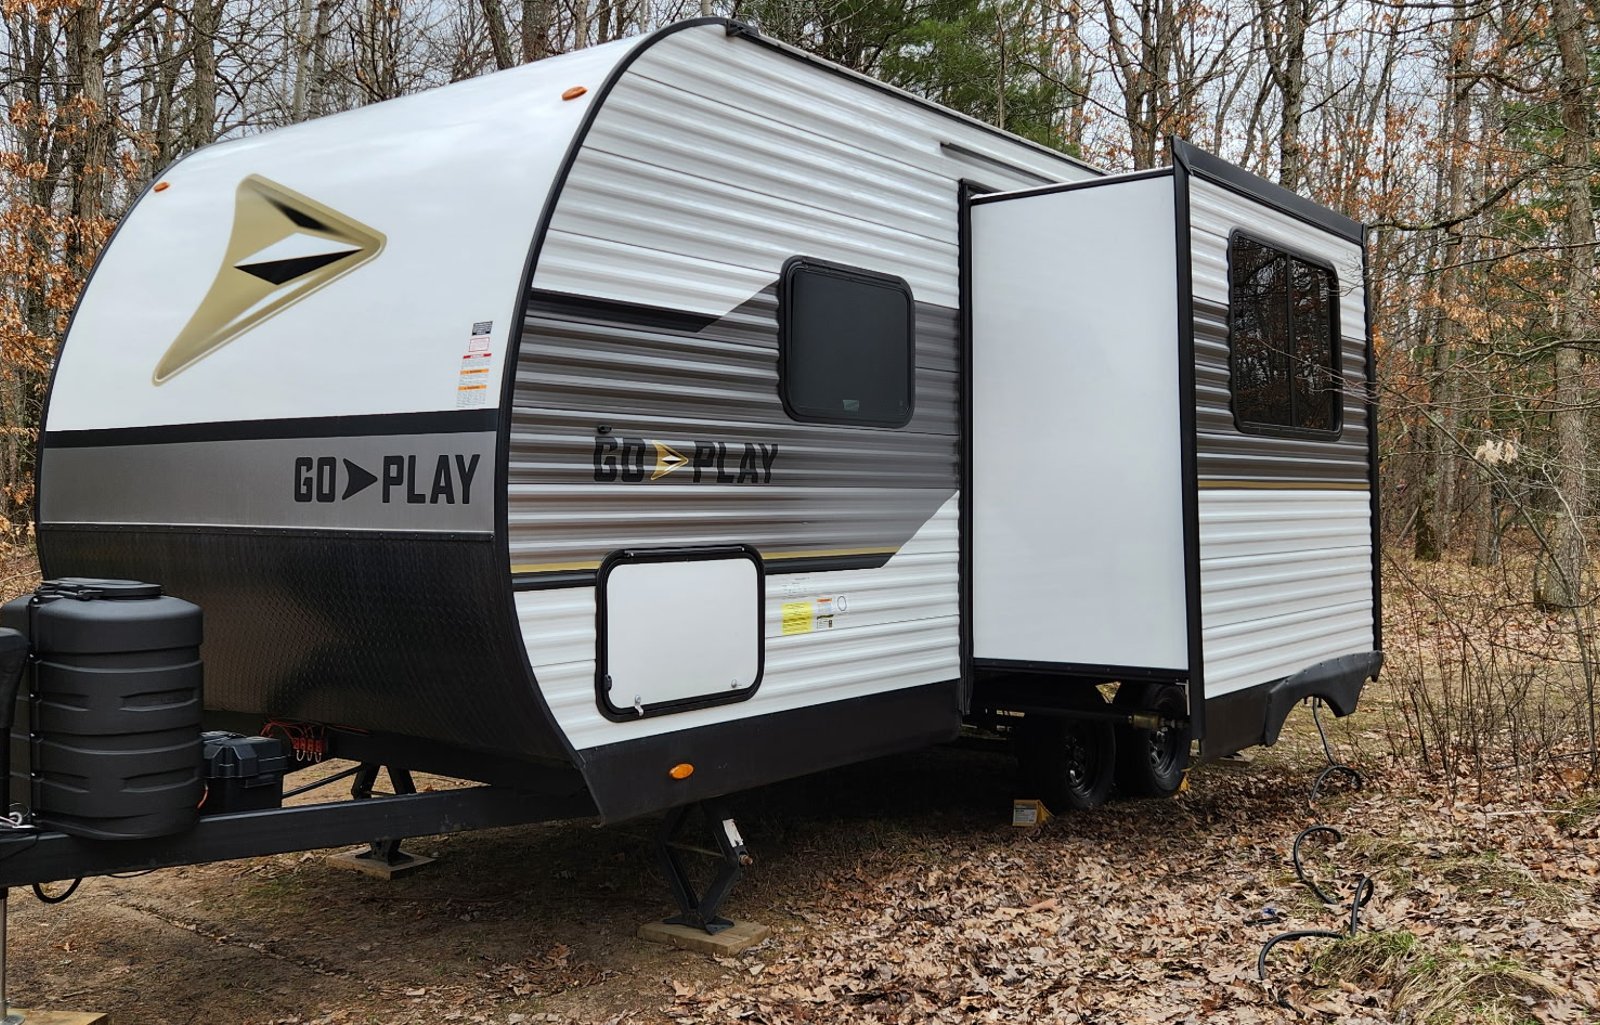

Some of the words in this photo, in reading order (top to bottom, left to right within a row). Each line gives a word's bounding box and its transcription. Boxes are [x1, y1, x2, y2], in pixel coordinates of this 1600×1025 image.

[294, 456, 337, 503] GO
[382, 454, 481, 504] PLAY
[593, 437, 646, 483] GO
[693, 441, 779, 484] PLAY
